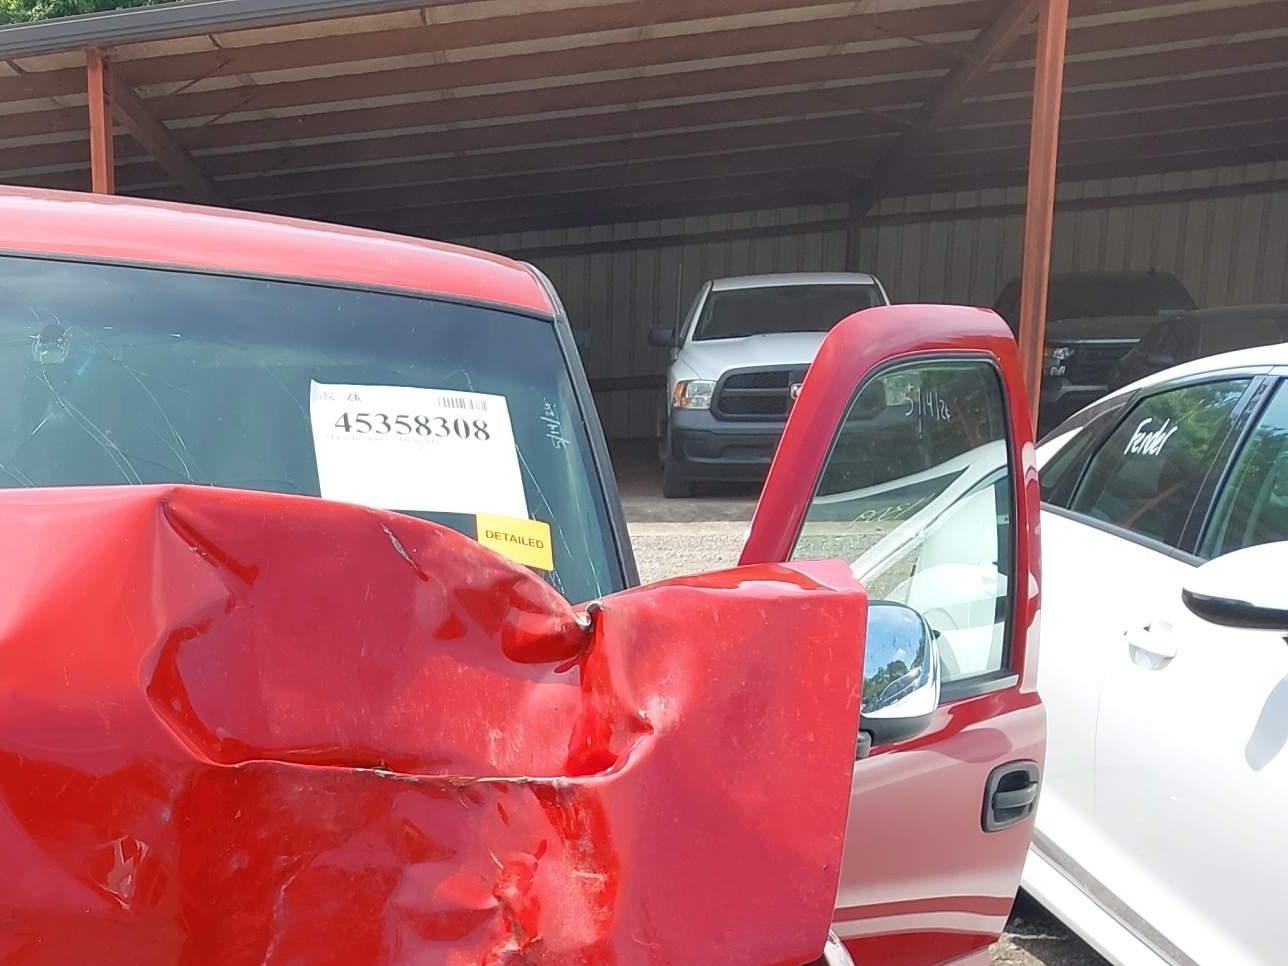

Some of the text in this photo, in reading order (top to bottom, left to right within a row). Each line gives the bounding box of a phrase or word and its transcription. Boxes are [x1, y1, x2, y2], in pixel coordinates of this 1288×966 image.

[334, 412, 491, 440] 45358308
[1123, 417, 1178, 456] Fender
[485, 528, 544, 550] DETAILED
